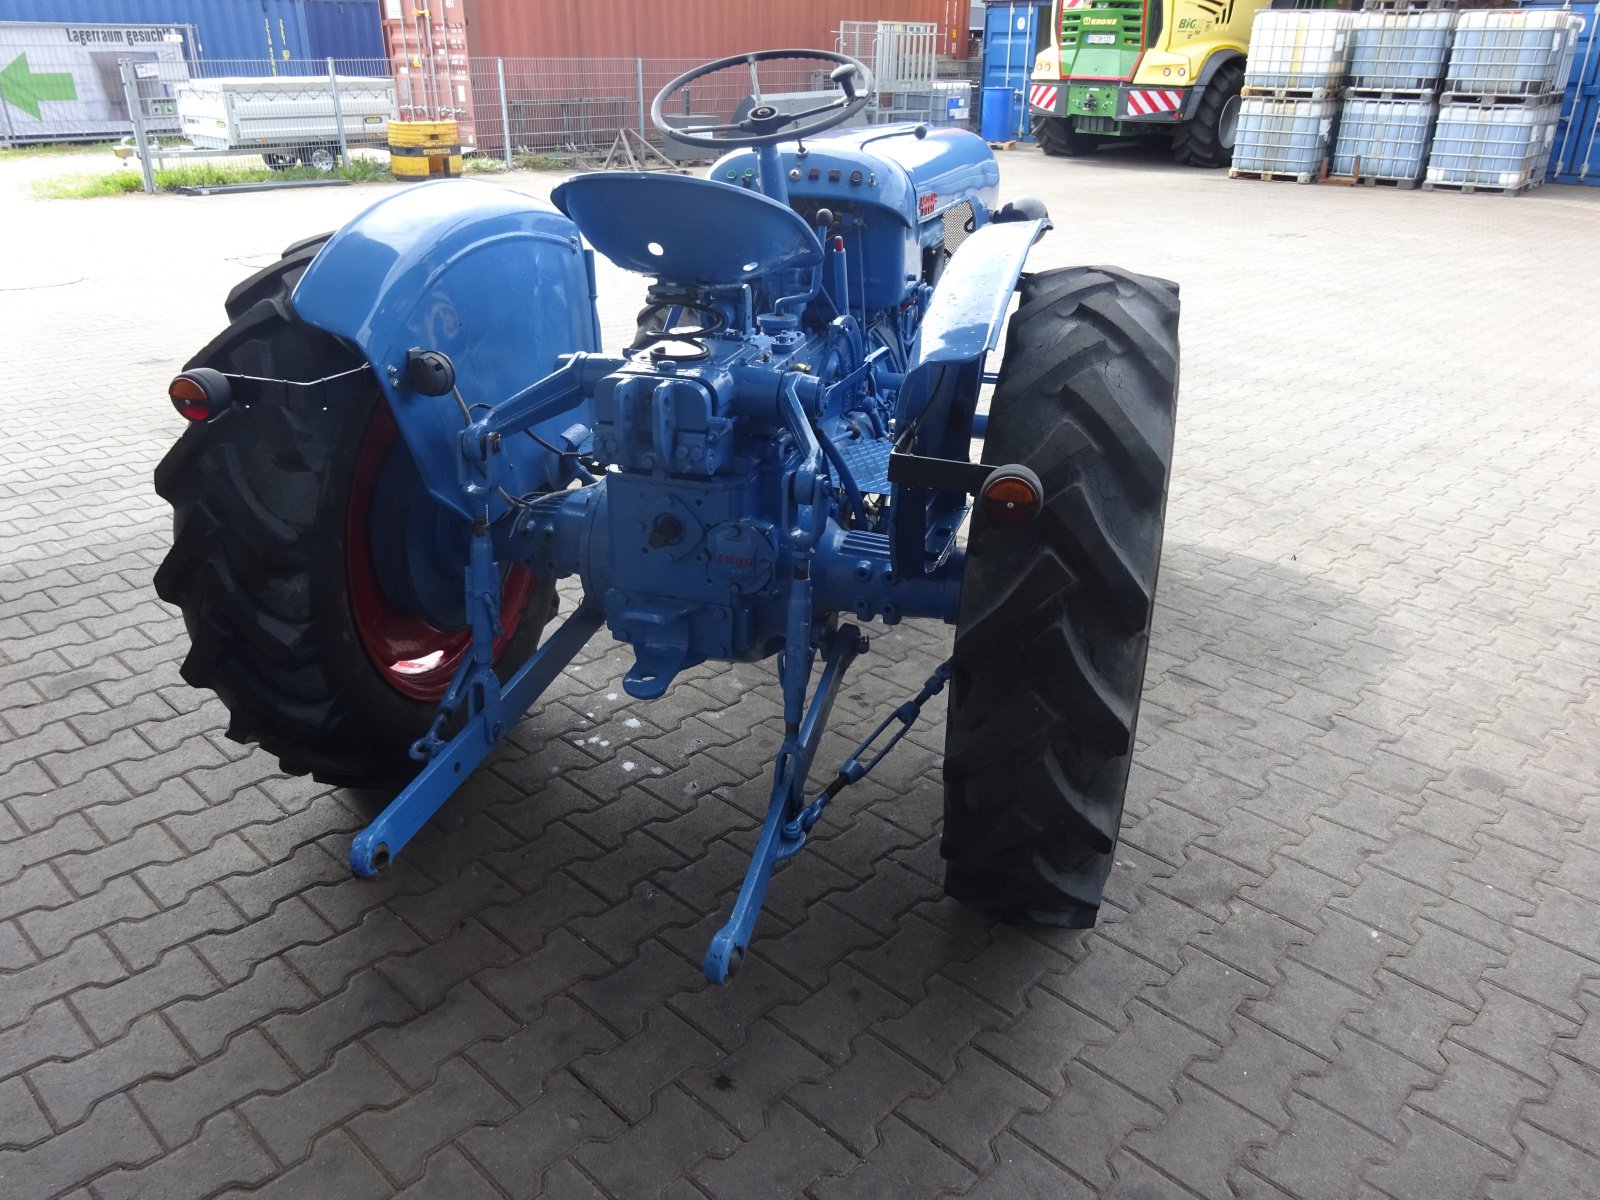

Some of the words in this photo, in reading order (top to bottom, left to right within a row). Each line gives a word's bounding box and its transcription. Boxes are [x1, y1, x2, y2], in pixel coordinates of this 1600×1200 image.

[1090, 18, 1118, 26] KRONE
[1178, 18, 1197, 29] BiG
[65, 27, 123, 46] Lagerraum
